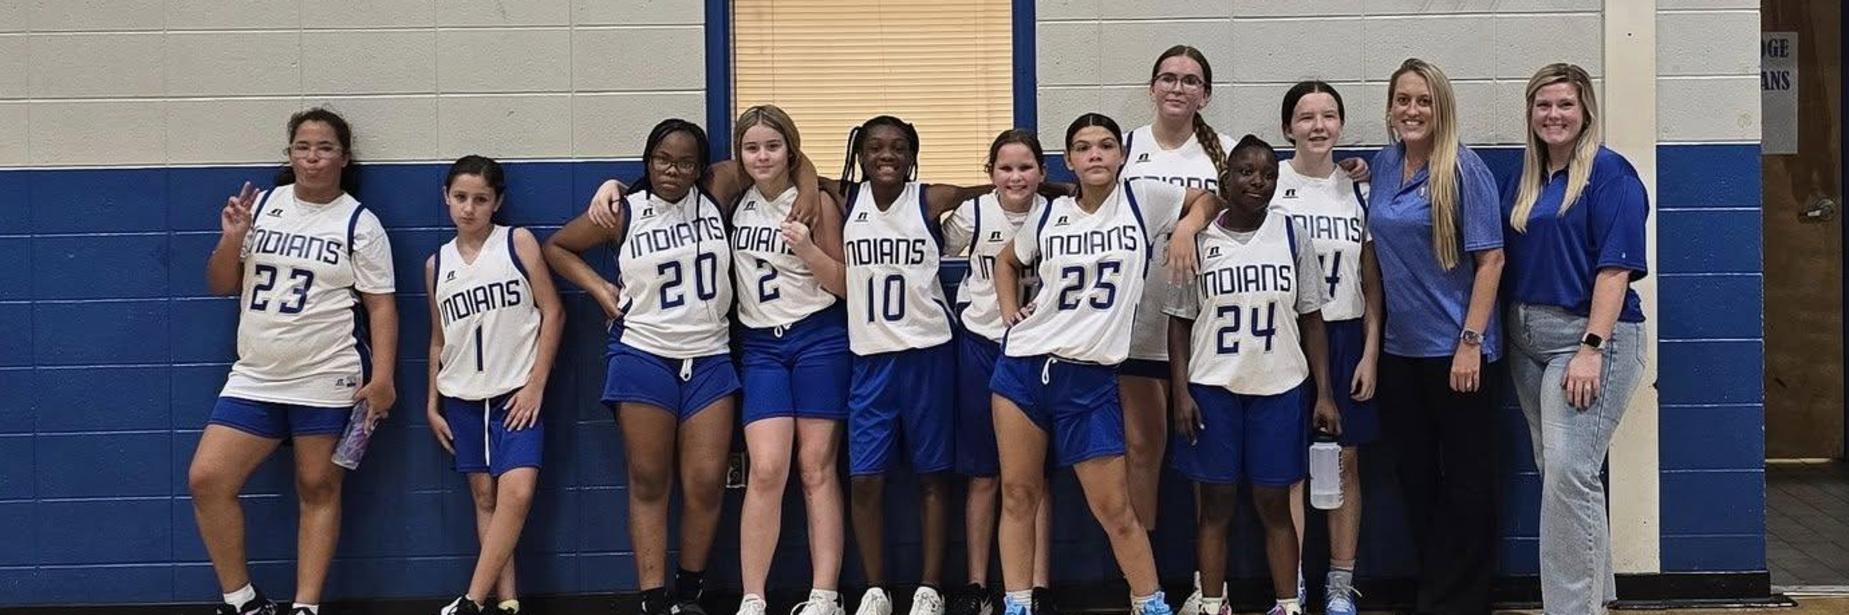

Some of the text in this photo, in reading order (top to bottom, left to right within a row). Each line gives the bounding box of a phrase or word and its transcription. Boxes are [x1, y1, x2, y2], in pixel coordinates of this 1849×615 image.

[248, 229, 342, 265] NDIANS
[631, 216, 724, 259] INDIANS
[846, 238, 926, 267] NDIANS
[1045, 225, 1137, 261] INDIANS
[250, 264, 314, 314] 23
[440, 280, 521, 328] INDIANS
[657, 252, 717, 310] 20
[755, 258, 780, 303] 2
[868, 274, 906, 323] 10
[1058, 261, 1122, 311] 25
[474, 325, 484, 372] 1
[1216, 302, 1276, 355] 24
